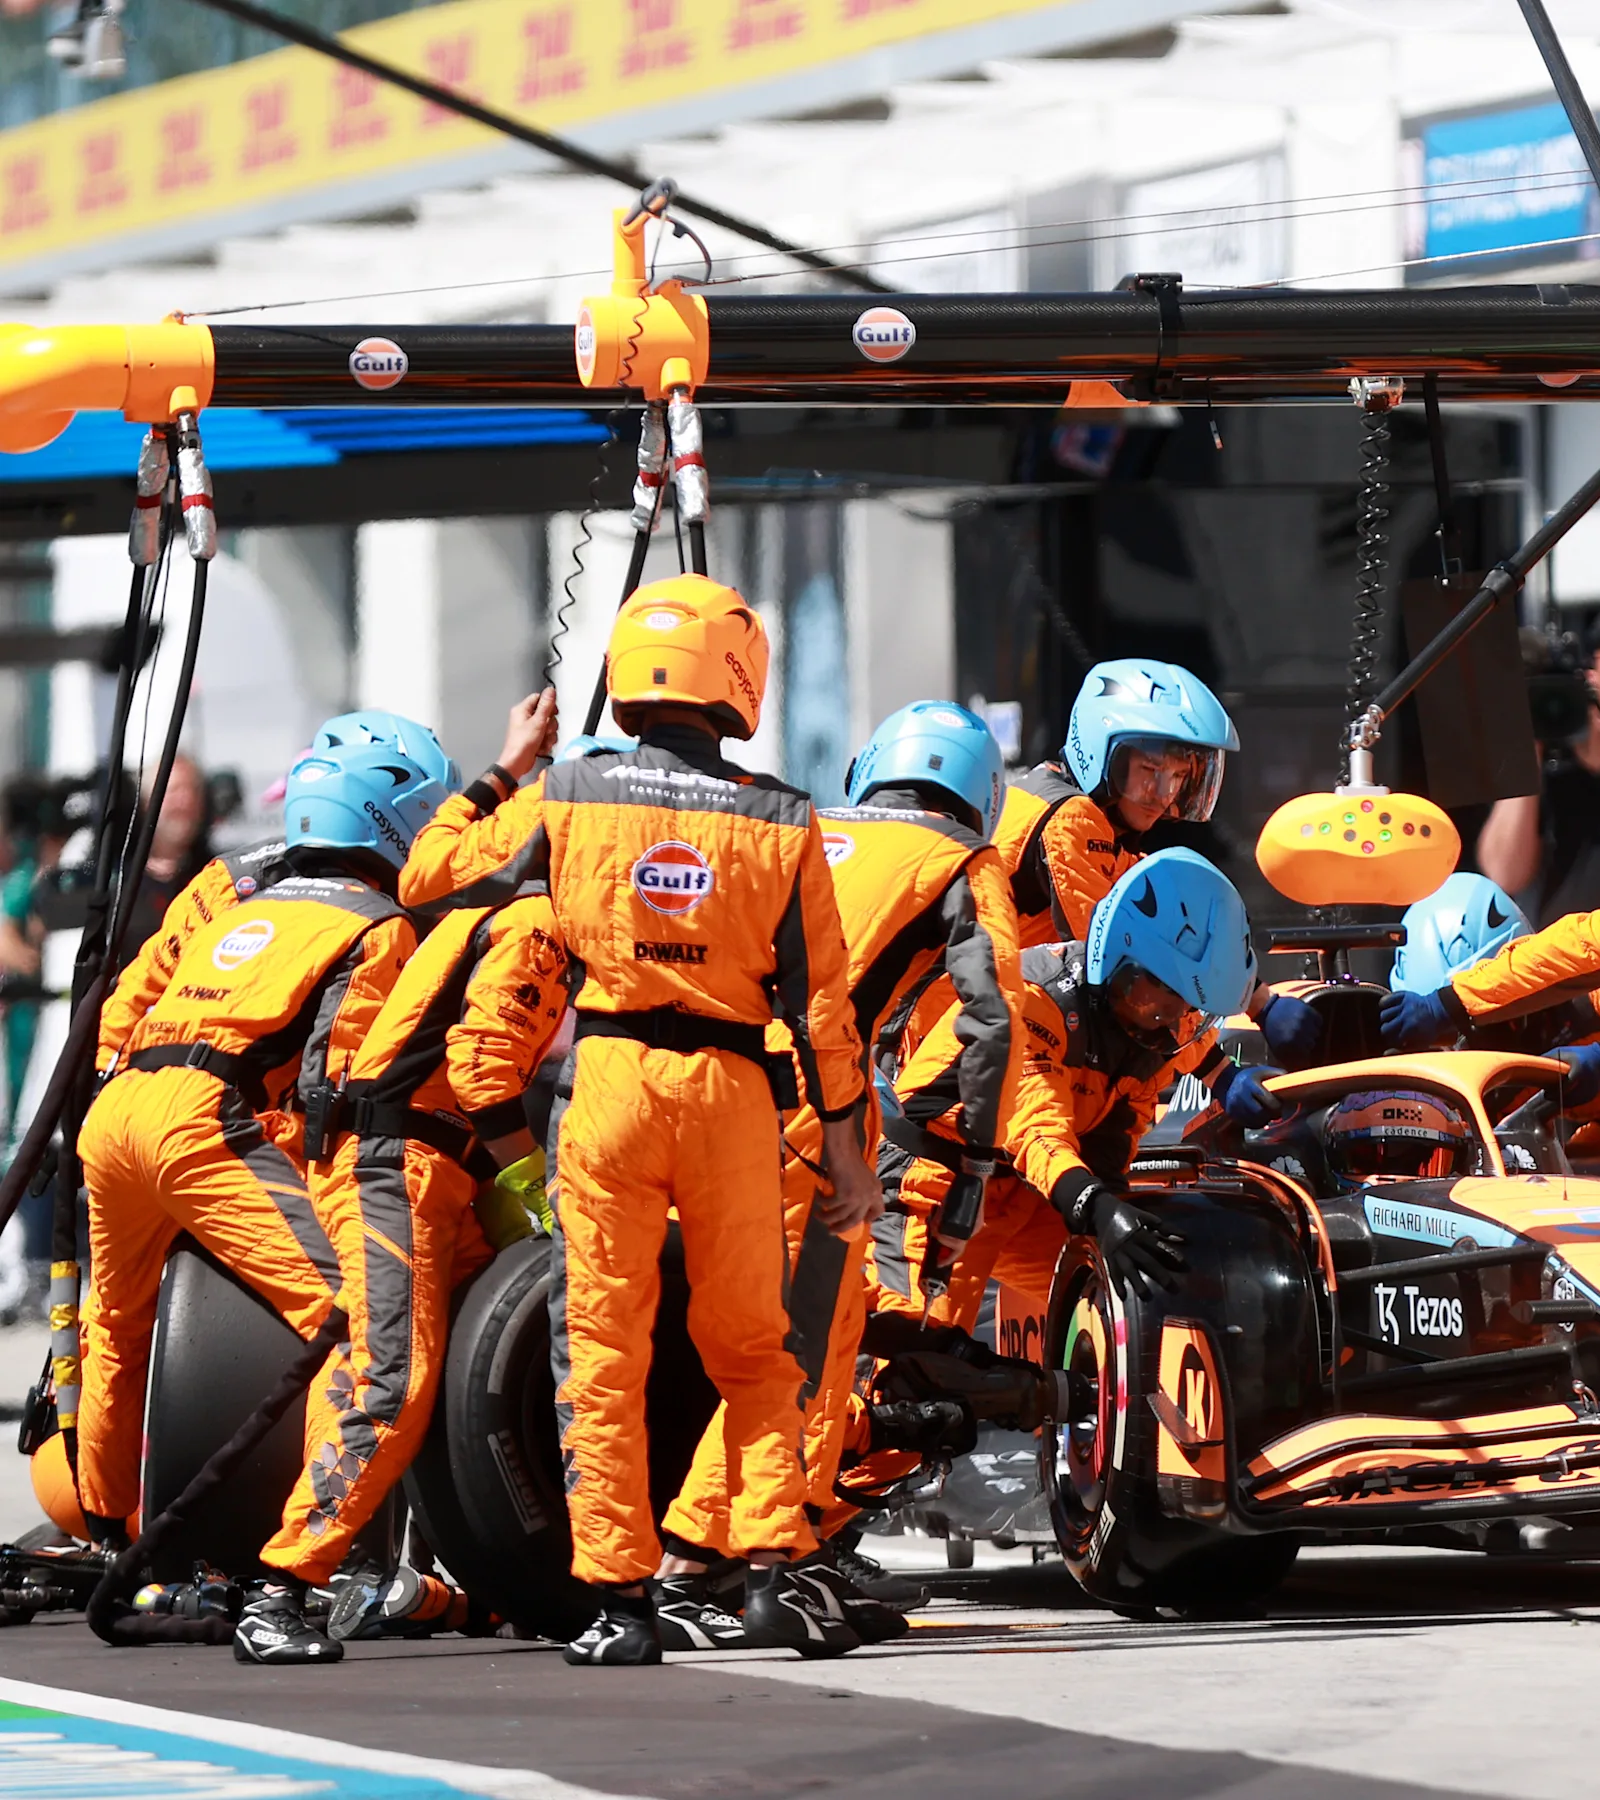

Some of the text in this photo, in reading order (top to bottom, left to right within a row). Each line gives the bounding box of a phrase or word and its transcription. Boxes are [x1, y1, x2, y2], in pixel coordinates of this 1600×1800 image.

[578, 331, 593, 351] Gulf
[857, 327, 911, 343] Gulf
[354, 356, 403, 372] Gulf
[601, 765, 738, 790] McLaren
[629, 784, 736, 804] FORMULA 1 TEAM
[363, 800, 410, 862] easypos
[637, 866, 708, 890] Gulf
[1090, 888, 1118, 971] easypost.
[221, 935, 267, 953] Gulf
[1383, 1108, 1423, 1122] OKX
[1384, 1126, 1428, 1138] cadence
[1129, 1159, 1180, 1172] Medallia
[1373, 1206, 1457, 1240] RICHARD MILLE
[1403, 1285, 1463, 1337] Tezos
[699, 1611, 743, 1628] sparc
